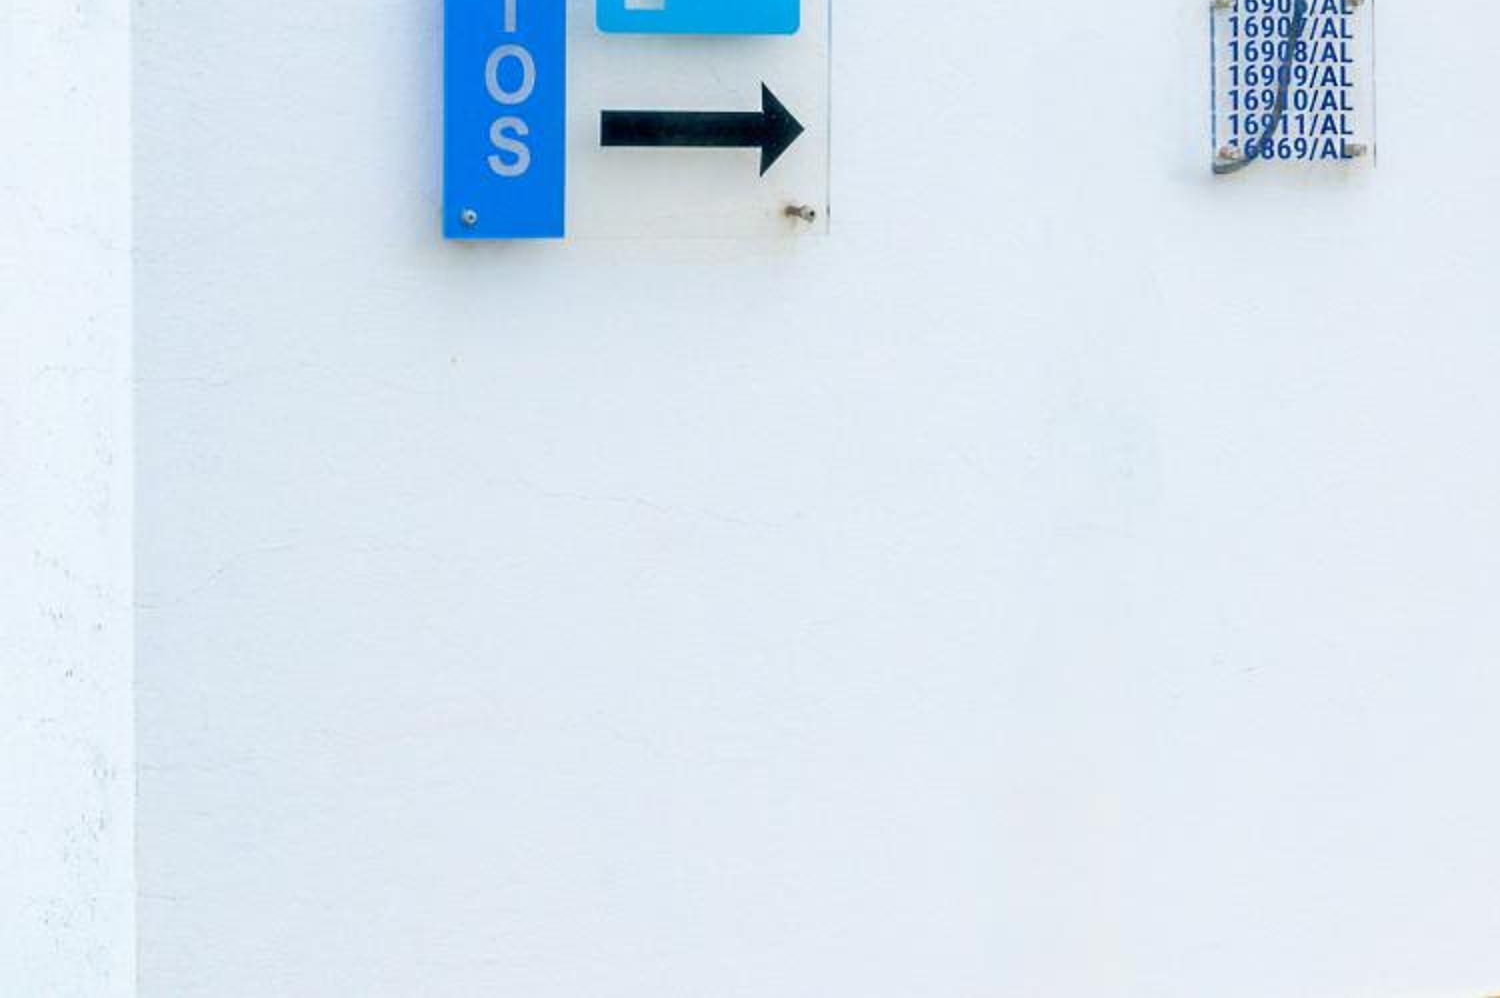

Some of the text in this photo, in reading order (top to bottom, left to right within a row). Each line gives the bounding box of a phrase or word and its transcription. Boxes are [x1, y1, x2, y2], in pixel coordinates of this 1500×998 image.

[1228, 16, 1354, 40] 16907/AL
[1228, 40, 1354, 64] 16908/AL
[1228, 89, 1354, 112] 16910/AL
[1228, 113, 1354, 136] 16911/AL
